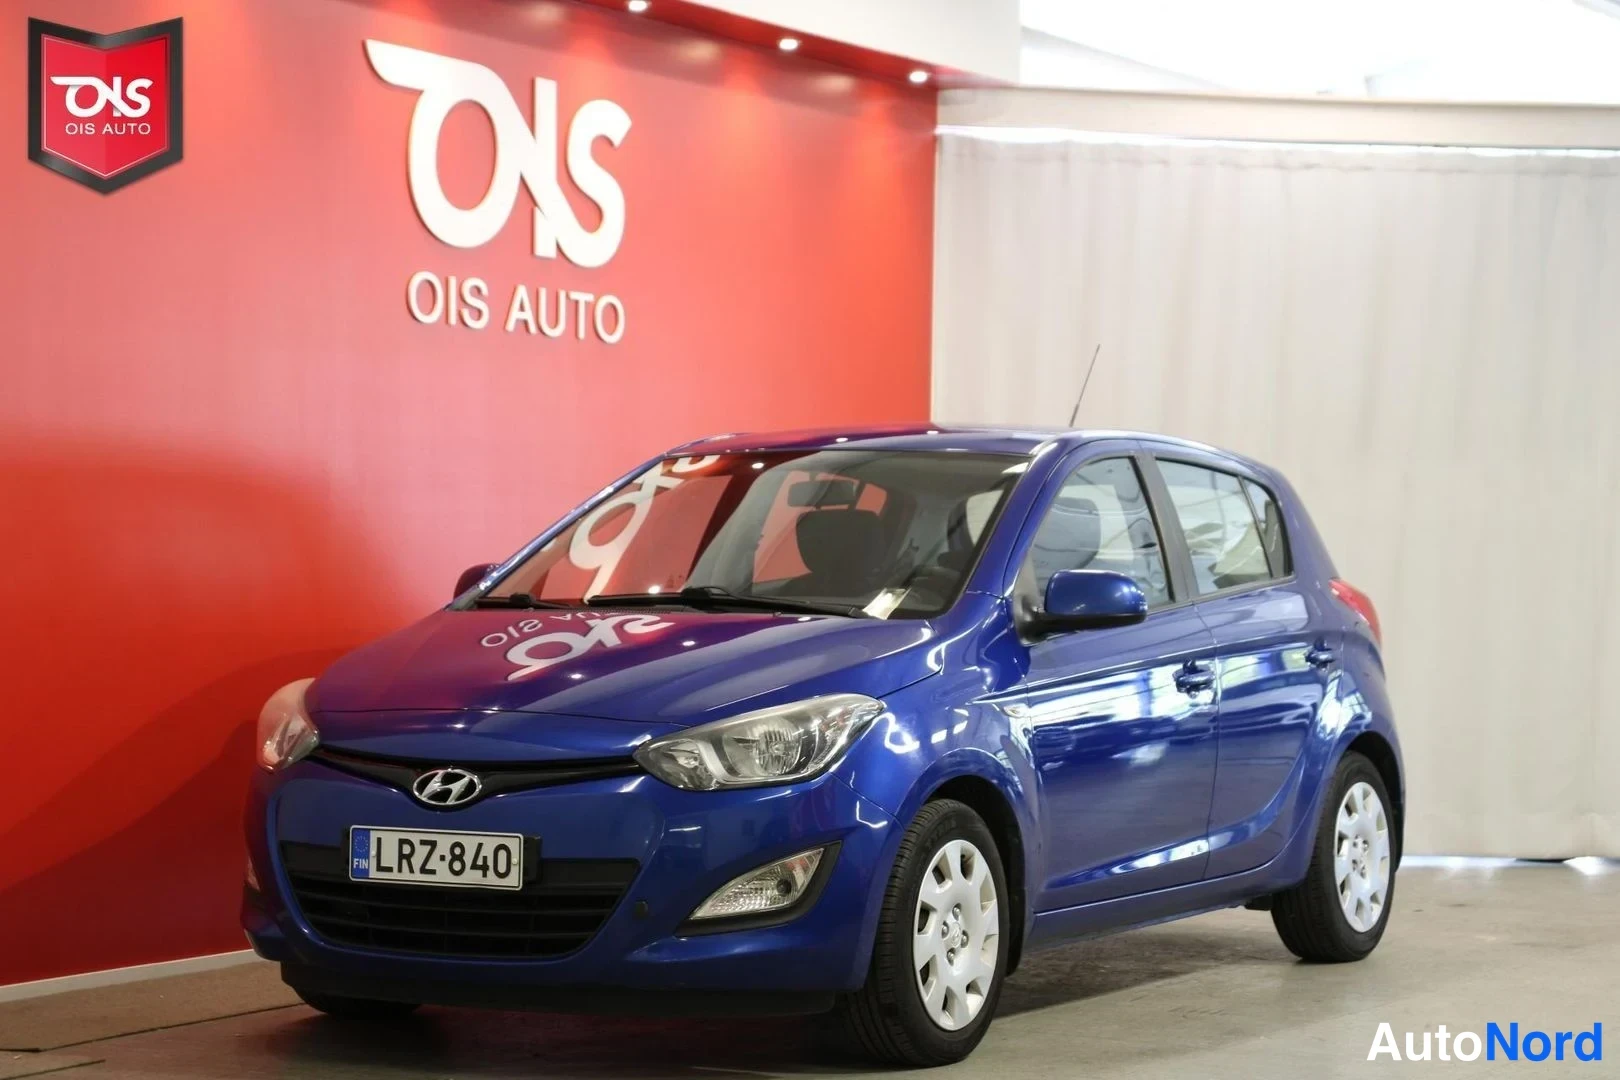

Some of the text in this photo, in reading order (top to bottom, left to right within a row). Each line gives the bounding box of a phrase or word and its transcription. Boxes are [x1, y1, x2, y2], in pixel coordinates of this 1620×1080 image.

[406, 270, 625, 344] OIS AUTO
[353, 858, 369, 869] FIN
[375, 837, 512, 879] LRZ-840
